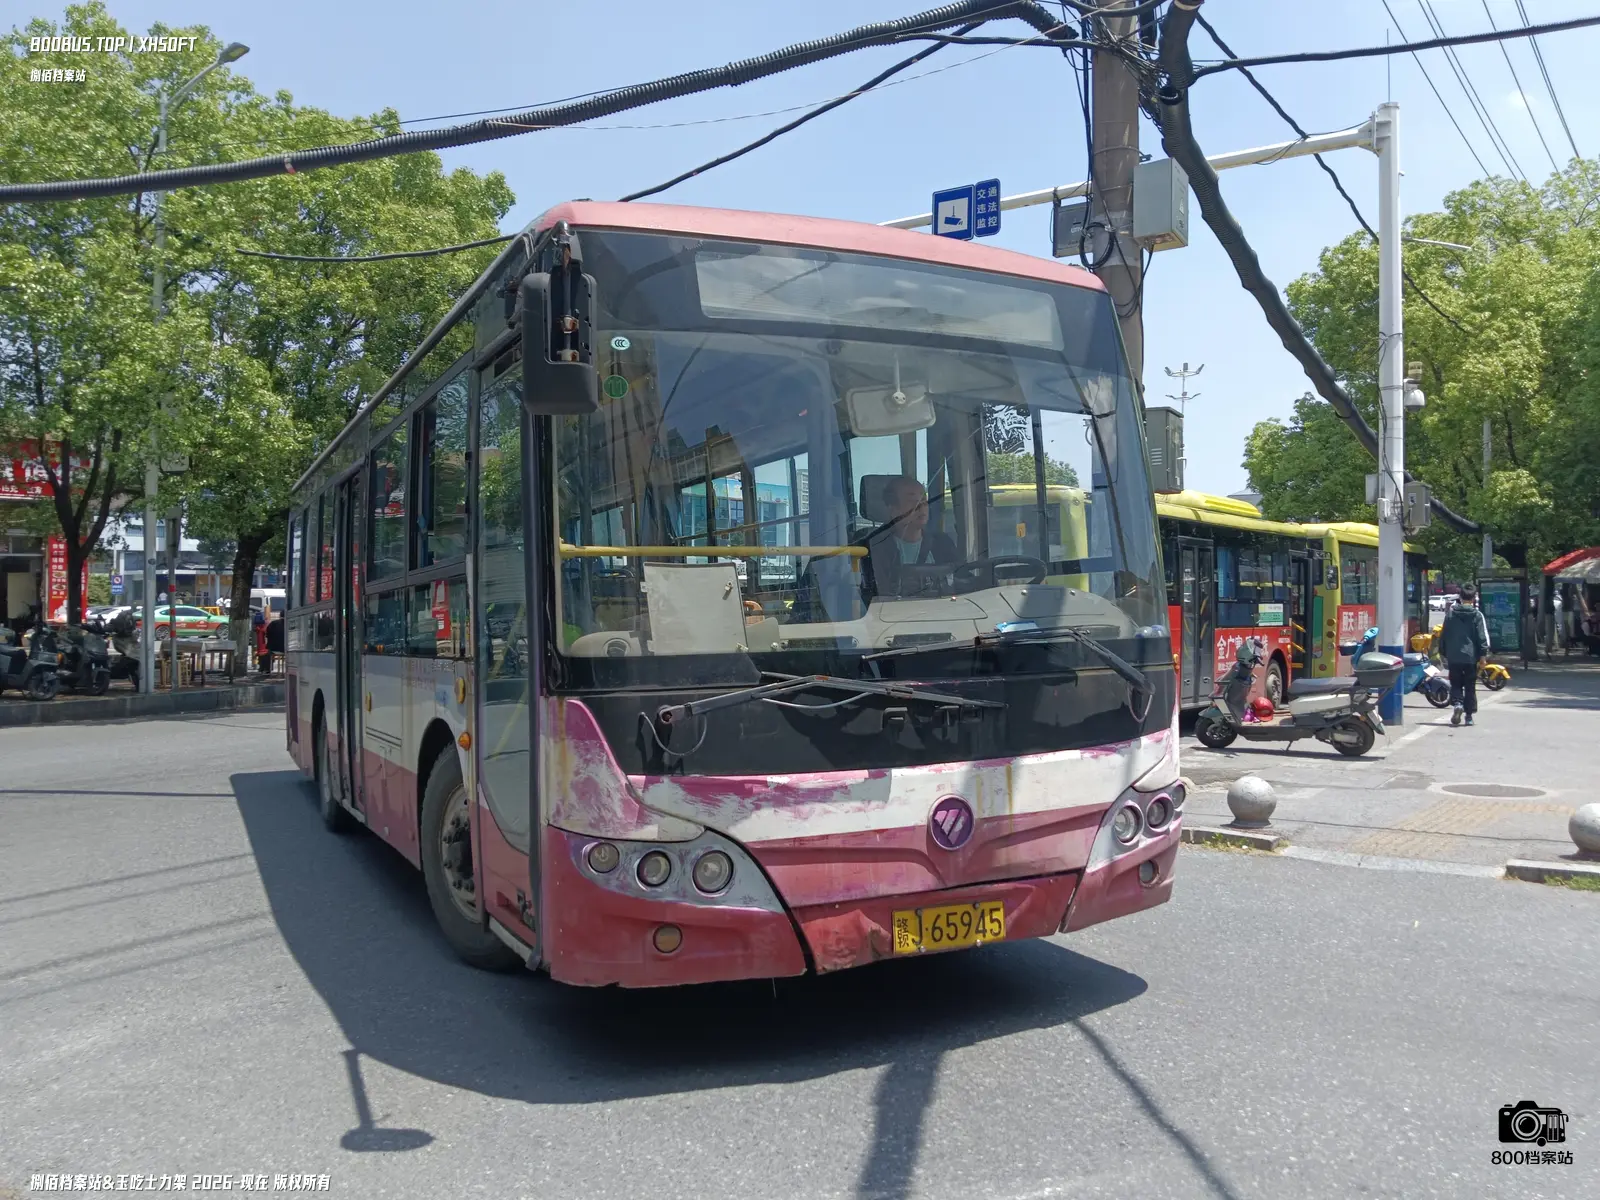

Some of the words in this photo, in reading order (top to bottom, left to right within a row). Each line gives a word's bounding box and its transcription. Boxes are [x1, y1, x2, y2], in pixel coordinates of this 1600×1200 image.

[977, 186, 998, 200] 交通
[977, 201, 998, 214] 违法
[977, 215, 998, 229] 监控
